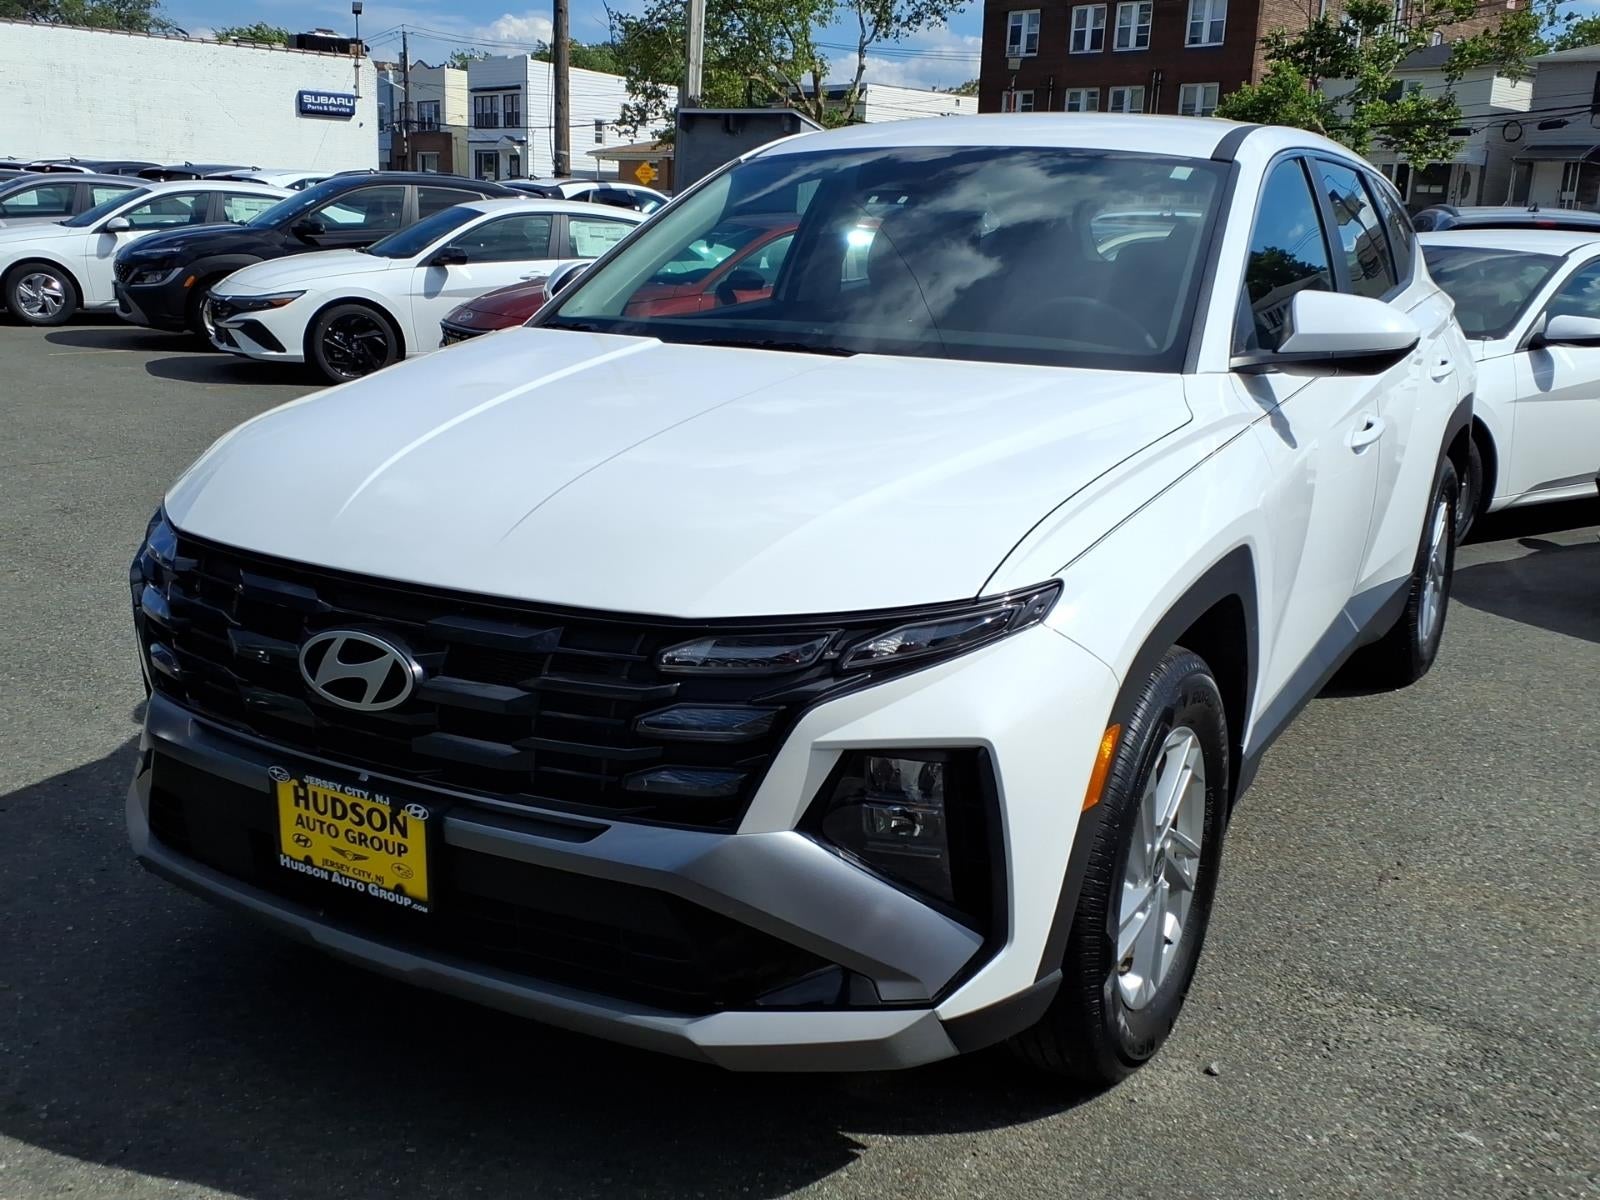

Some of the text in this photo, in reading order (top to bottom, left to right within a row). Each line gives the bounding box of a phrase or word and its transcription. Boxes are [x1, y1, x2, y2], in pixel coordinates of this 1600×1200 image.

[303, 95, 353, 106] SUBARU
[304, 775, 342, 792] JERSEY
[375, 794, 390, 805] NJ
[293, 784, 408, 839] HUDSON
[295, 814, 408, 857] AUTO GROUP
[322, 859, 351, 872] JERSEY
[375, 874, 385, 885] NJ
